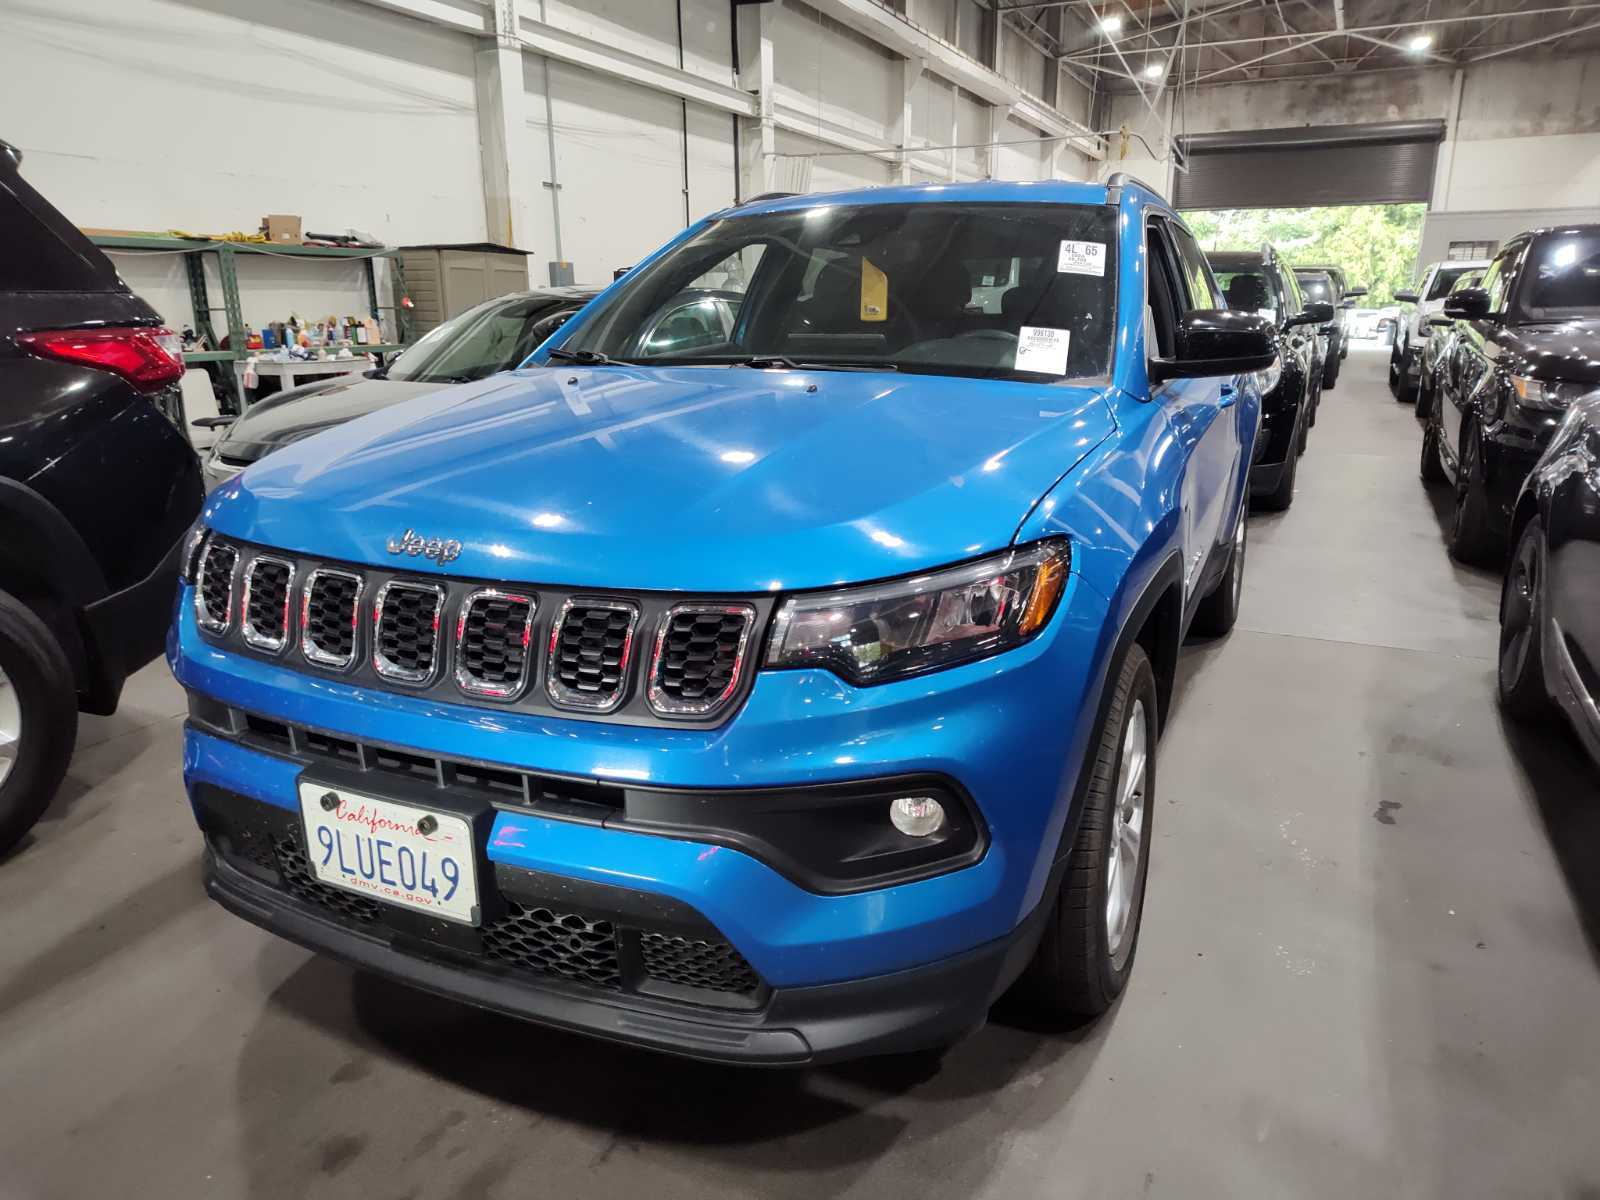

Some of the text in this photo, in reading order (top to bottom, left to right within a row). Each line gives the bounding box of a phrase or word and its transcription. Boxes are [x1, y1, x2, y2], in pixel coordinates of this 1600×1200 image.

[1085, 244, 1098, 257] 65
[386, 528, 463, 567] Jeep
[317, 824, 460, 901] 9LUE049
[350, 876, 433, 905] dmv.ca.gov
